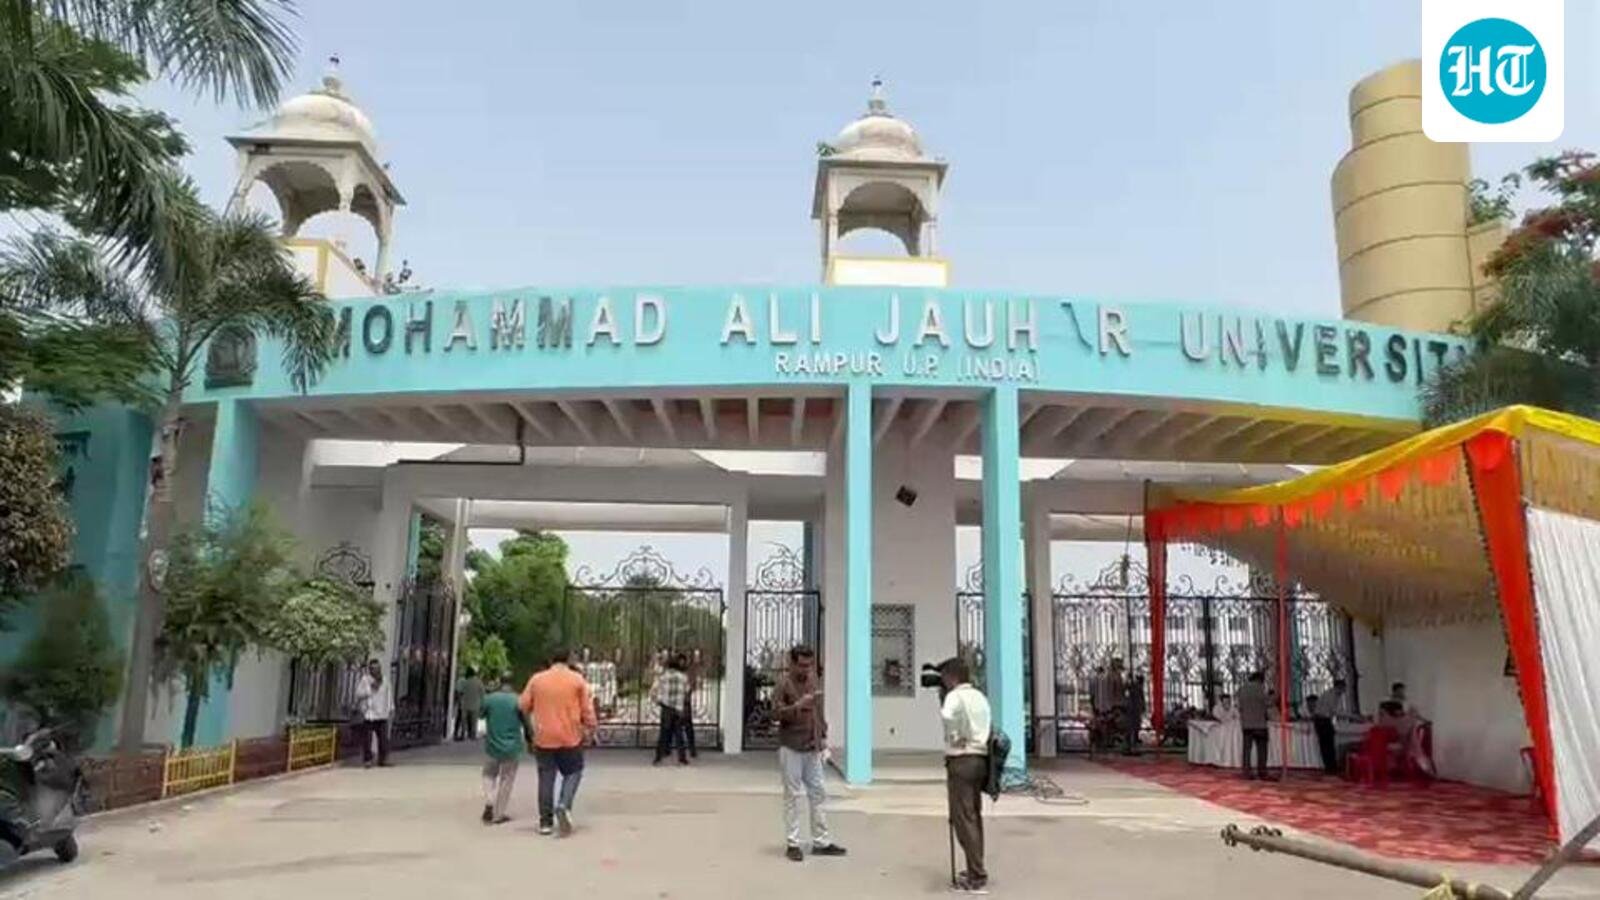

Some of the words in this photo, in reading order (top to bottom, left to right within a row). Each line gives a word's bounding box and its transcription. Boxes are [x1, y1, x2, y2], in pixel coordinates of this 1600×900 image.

[720, 292, 822, 346] ALI
[1180, 309, 1478, 385] UNIVERSIT
[775, 352, 883, 377] RAMPUR
